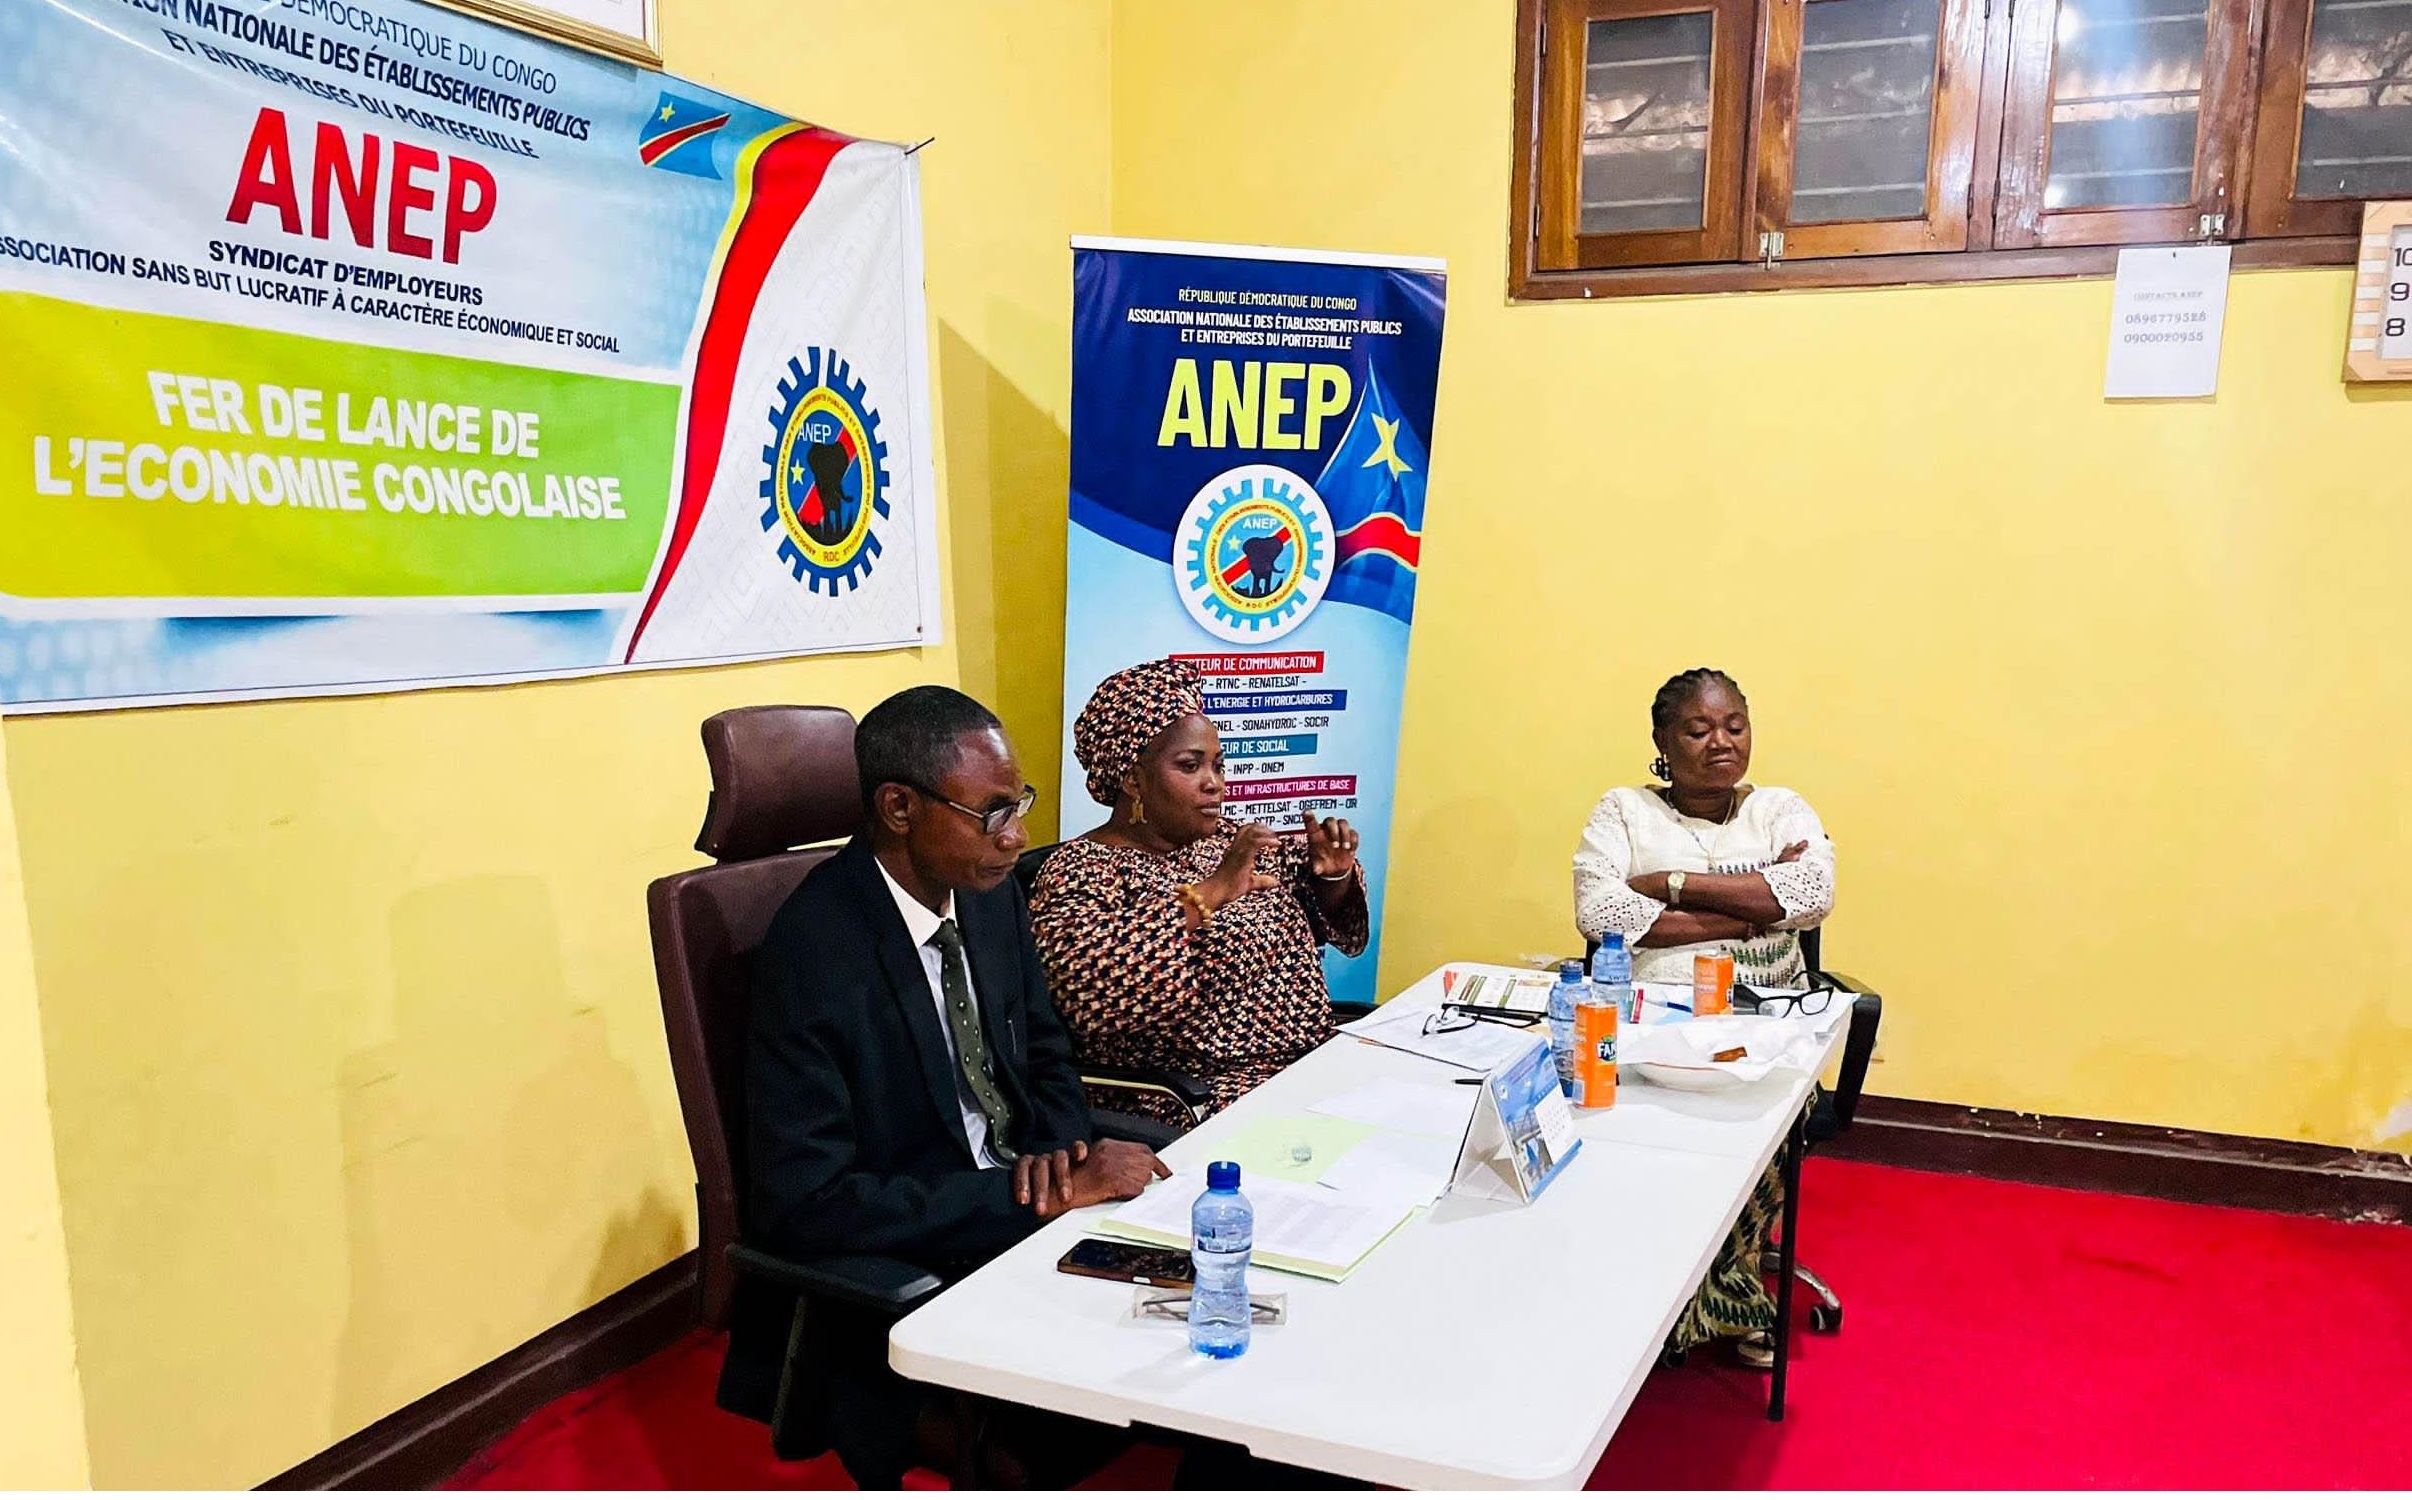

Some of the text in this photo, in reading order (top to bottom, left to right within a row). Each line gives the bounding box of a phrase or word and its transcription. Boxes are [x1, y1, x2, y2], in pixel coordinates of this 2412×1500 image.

[185, 0, 591, 141] NATIONALE DES ÉTABLISSEMENTS PUBLICS
[459, 44, 487, 71] DU
[492, 55, 557, 94] CONGO
[161, 28, 540, 159] ET ENTREPRISES DU PORTEFEUILLE
[226, 106, 499, 265] ANEP
[209, 240, 483, 305] SYNDICAT D'EMPLOYEURS
[1178, 286, 1357, 311] RÉPUBLIQUE DÉMOCRATIQUE DU CONGO
[2390, 282, 2410, 302] 9
[132, 257, 190, 285] SANS
[194, 269, 232, 292] BUT
[236, 277, 328, 308] LUCRATIF
[332, 288, 347, 311] À
[350, 295, 454, 328] CARACTÈRE
[457, 308, 554, 344] ÉCONOMIQUE
[557, 328, 574, 346] ET
[576, 331, 620, 353] SOCIAL
[1127, 308, 1402, 335] ASSOCIATION NATIONALE DES ÉTABLISSEMENTS PUBLICS
[2385, 317, 2405, 337] 8
[1181, 329, 1352, 350] ET ENTREPRISES DU PORTEFEUILLE
[147, 370, 541, 458] FER DE LANCE DE
[1156, 358, 1353, 451] ANEP
[797, 422, 832, 444] ANEP
[34, 436, 628, 520] L'ECONOMIE CONGOLAISE
[1242, 517, 1278, 530] ANEP
[1223, 658, 1236, 671] DE
[1238, 655, 1317, 671] COMMUNICATION
[1215, 677, 1240, 690] RTNC
[1248, 675, 1300, 690] RENATELSAT
[1252, 696, 1262, 708] ET
[1264, 693, 1333, 708] HYDROCARBURES
[1304, 716, 1329, 728] SOCIR
[1241, 741, 1255, 754] DE
[1256, 739, 1290, 753] SOCIAL
[1233, 762, 1254, 775] INPP
[1261, 762, 1284, 774] ONEM
[1232, 786, 1243, 797] ET
[1244, 780, 1316, 795] INFRASTRUCTURES
[1317, 779, 1329, 790] DE
[1329, 779, 1350, 790] BASE
[1245, 800, 1292, 815] METTELSAT
